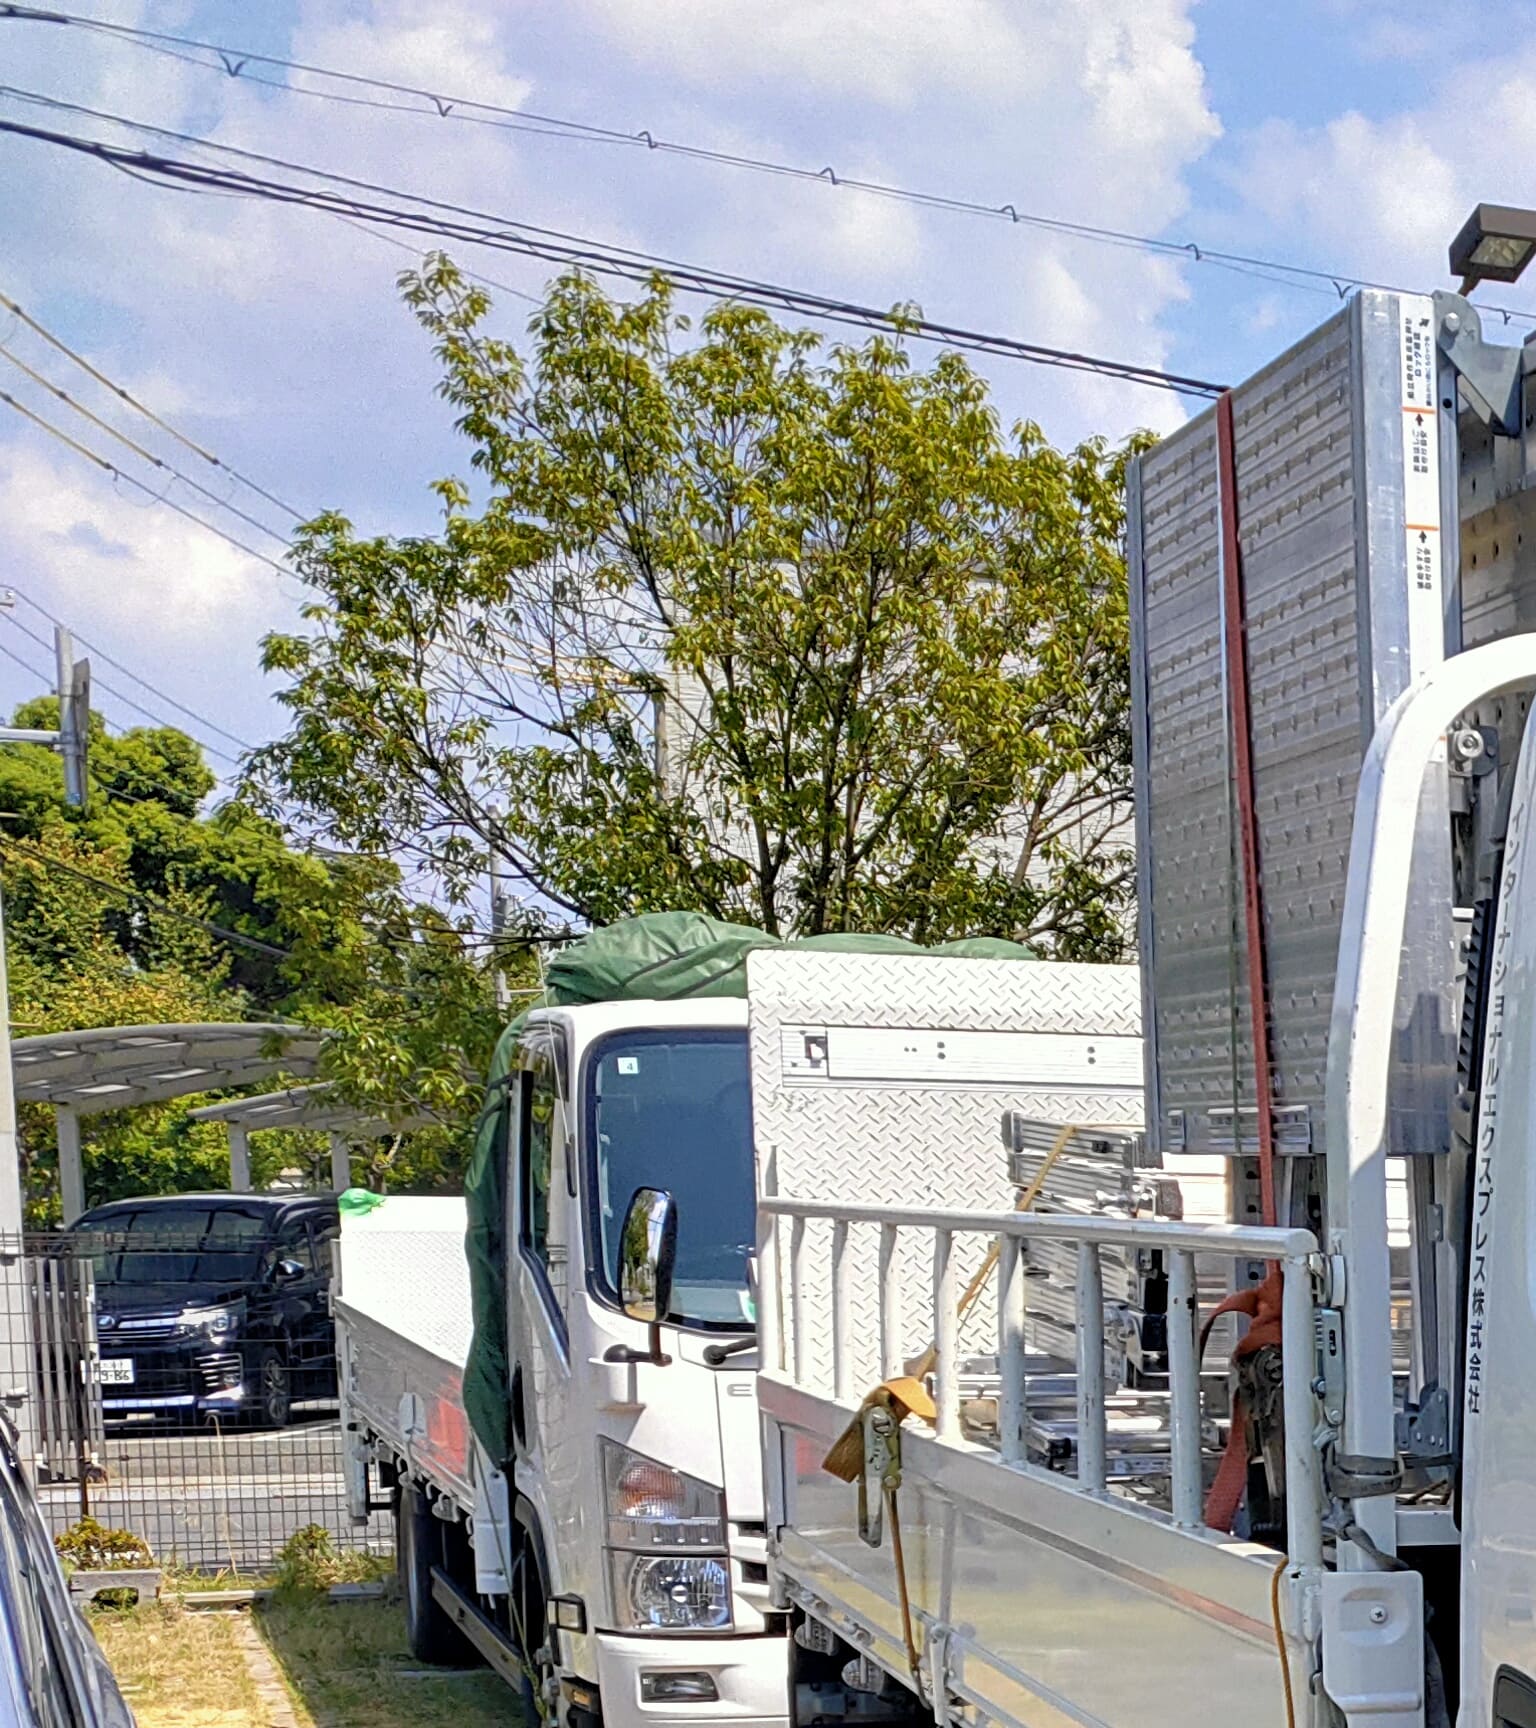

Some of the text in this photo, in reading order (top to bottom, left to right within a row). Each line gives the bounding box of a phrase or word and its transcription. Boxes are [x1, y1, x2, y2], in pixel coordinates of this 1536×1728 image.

[1467, 802, 1525, 1415] インターナショナルエクスプレス株式会社
